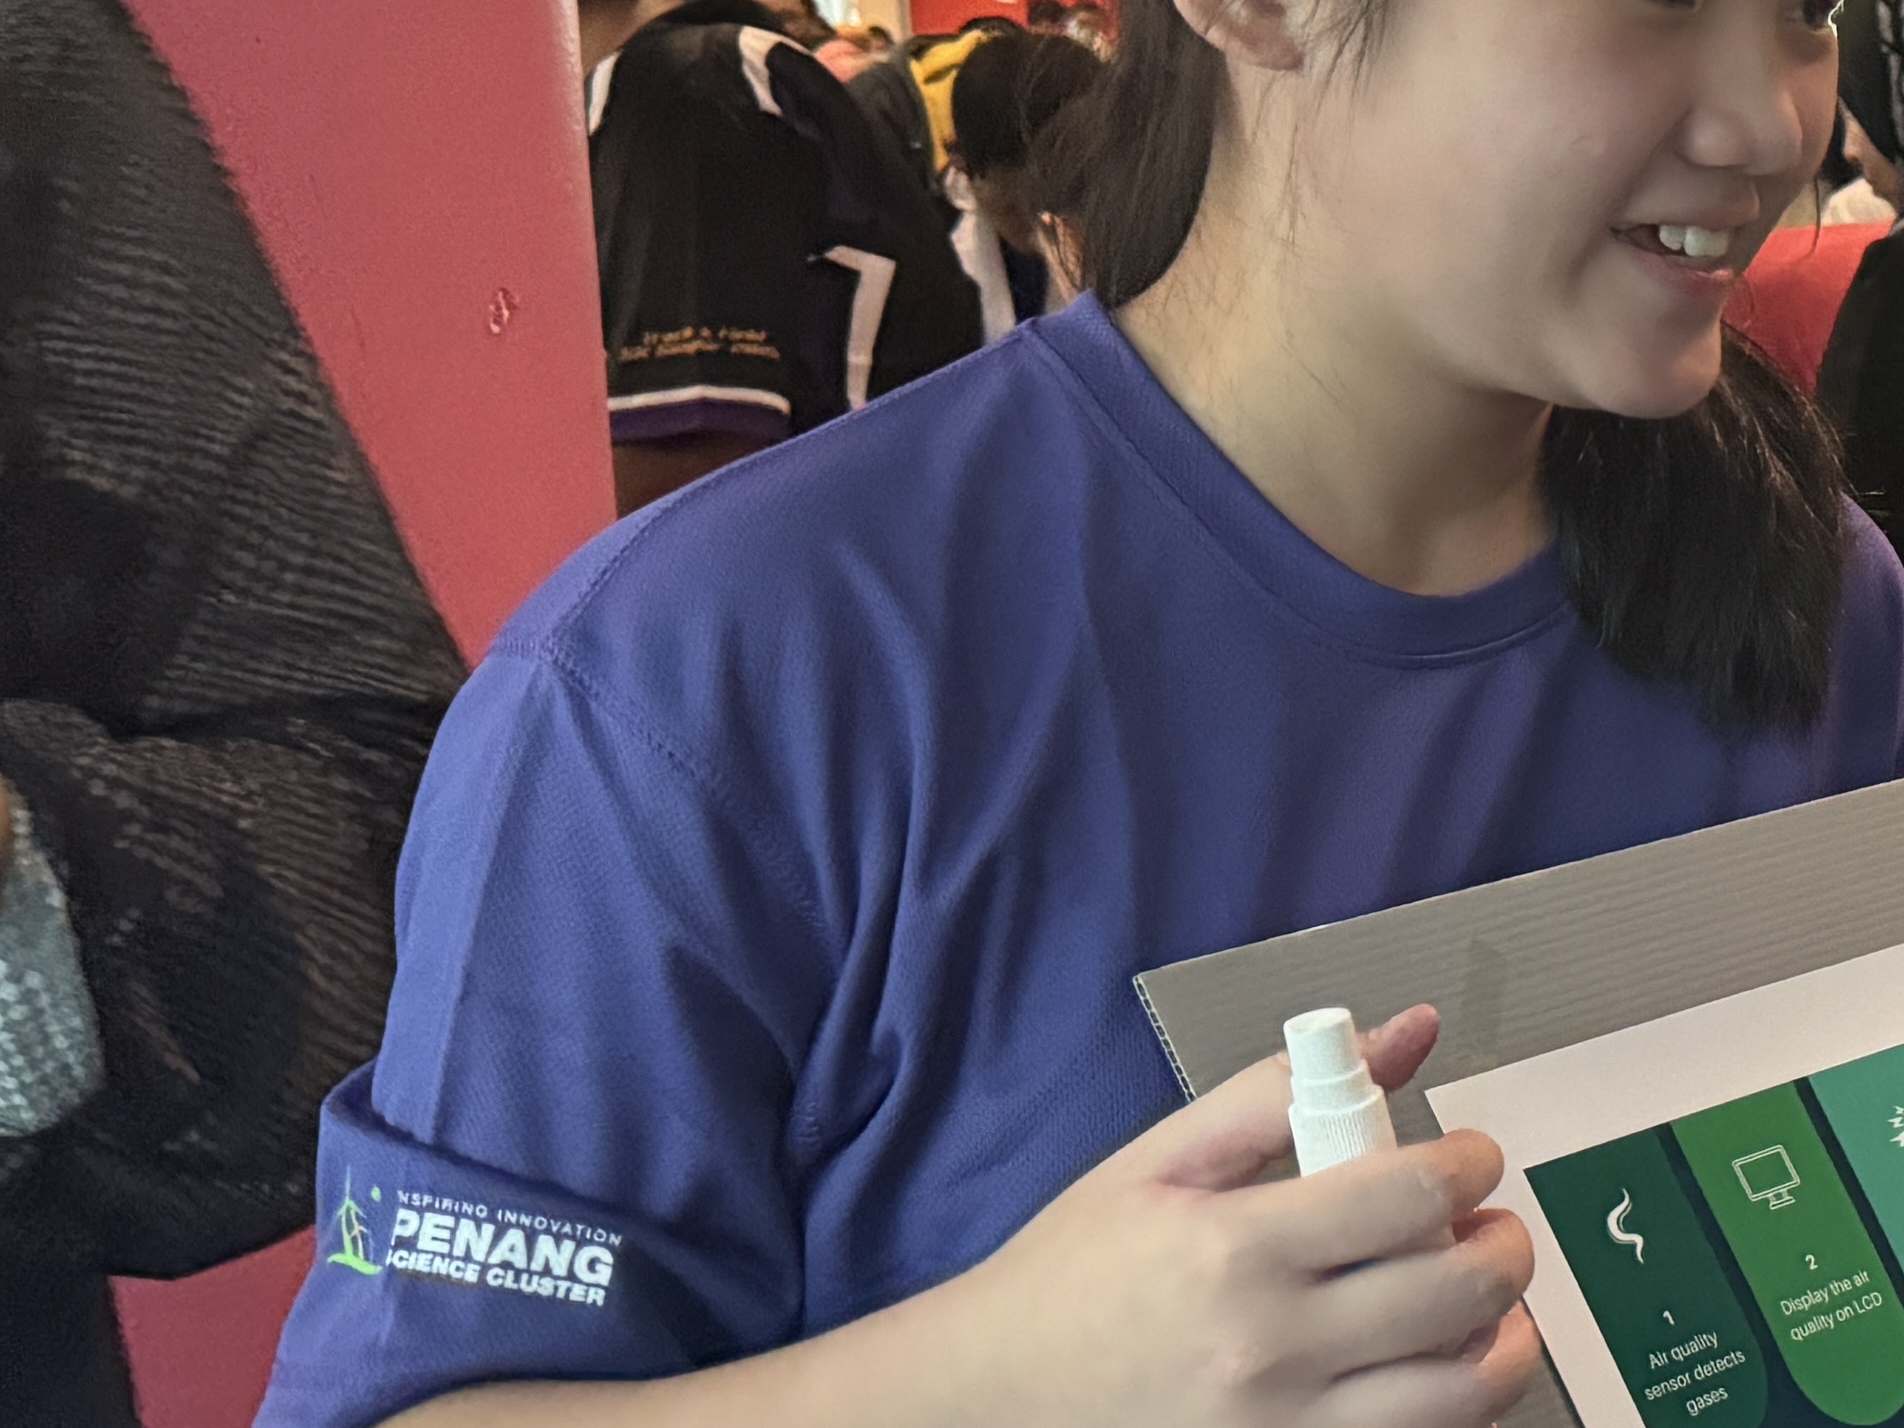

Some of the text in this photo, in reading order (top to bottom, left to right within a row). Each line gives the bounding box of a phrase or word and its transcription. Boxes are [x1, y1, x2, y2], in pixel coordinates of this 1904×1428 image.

[397, 1189, 624, 1248] NSPIRING INNOVATION
[390, 1207, 615, 1289] PENANG
[1805, 1254, 1819, 1270] 2
[486, 1266, 606, 1307] CLUSTER
[1780, 1270, 1870, 1315] Display the air
[1662, 1310, 1675, 1326] 1
[1790, 1291, 1883, 1342] quality on LCD
[1648, 1332, 1718, 1370] Air quality
[1644, 1350, 1746, 1401] sensor detects
[1686, 1387, 1728, 1417] gases
